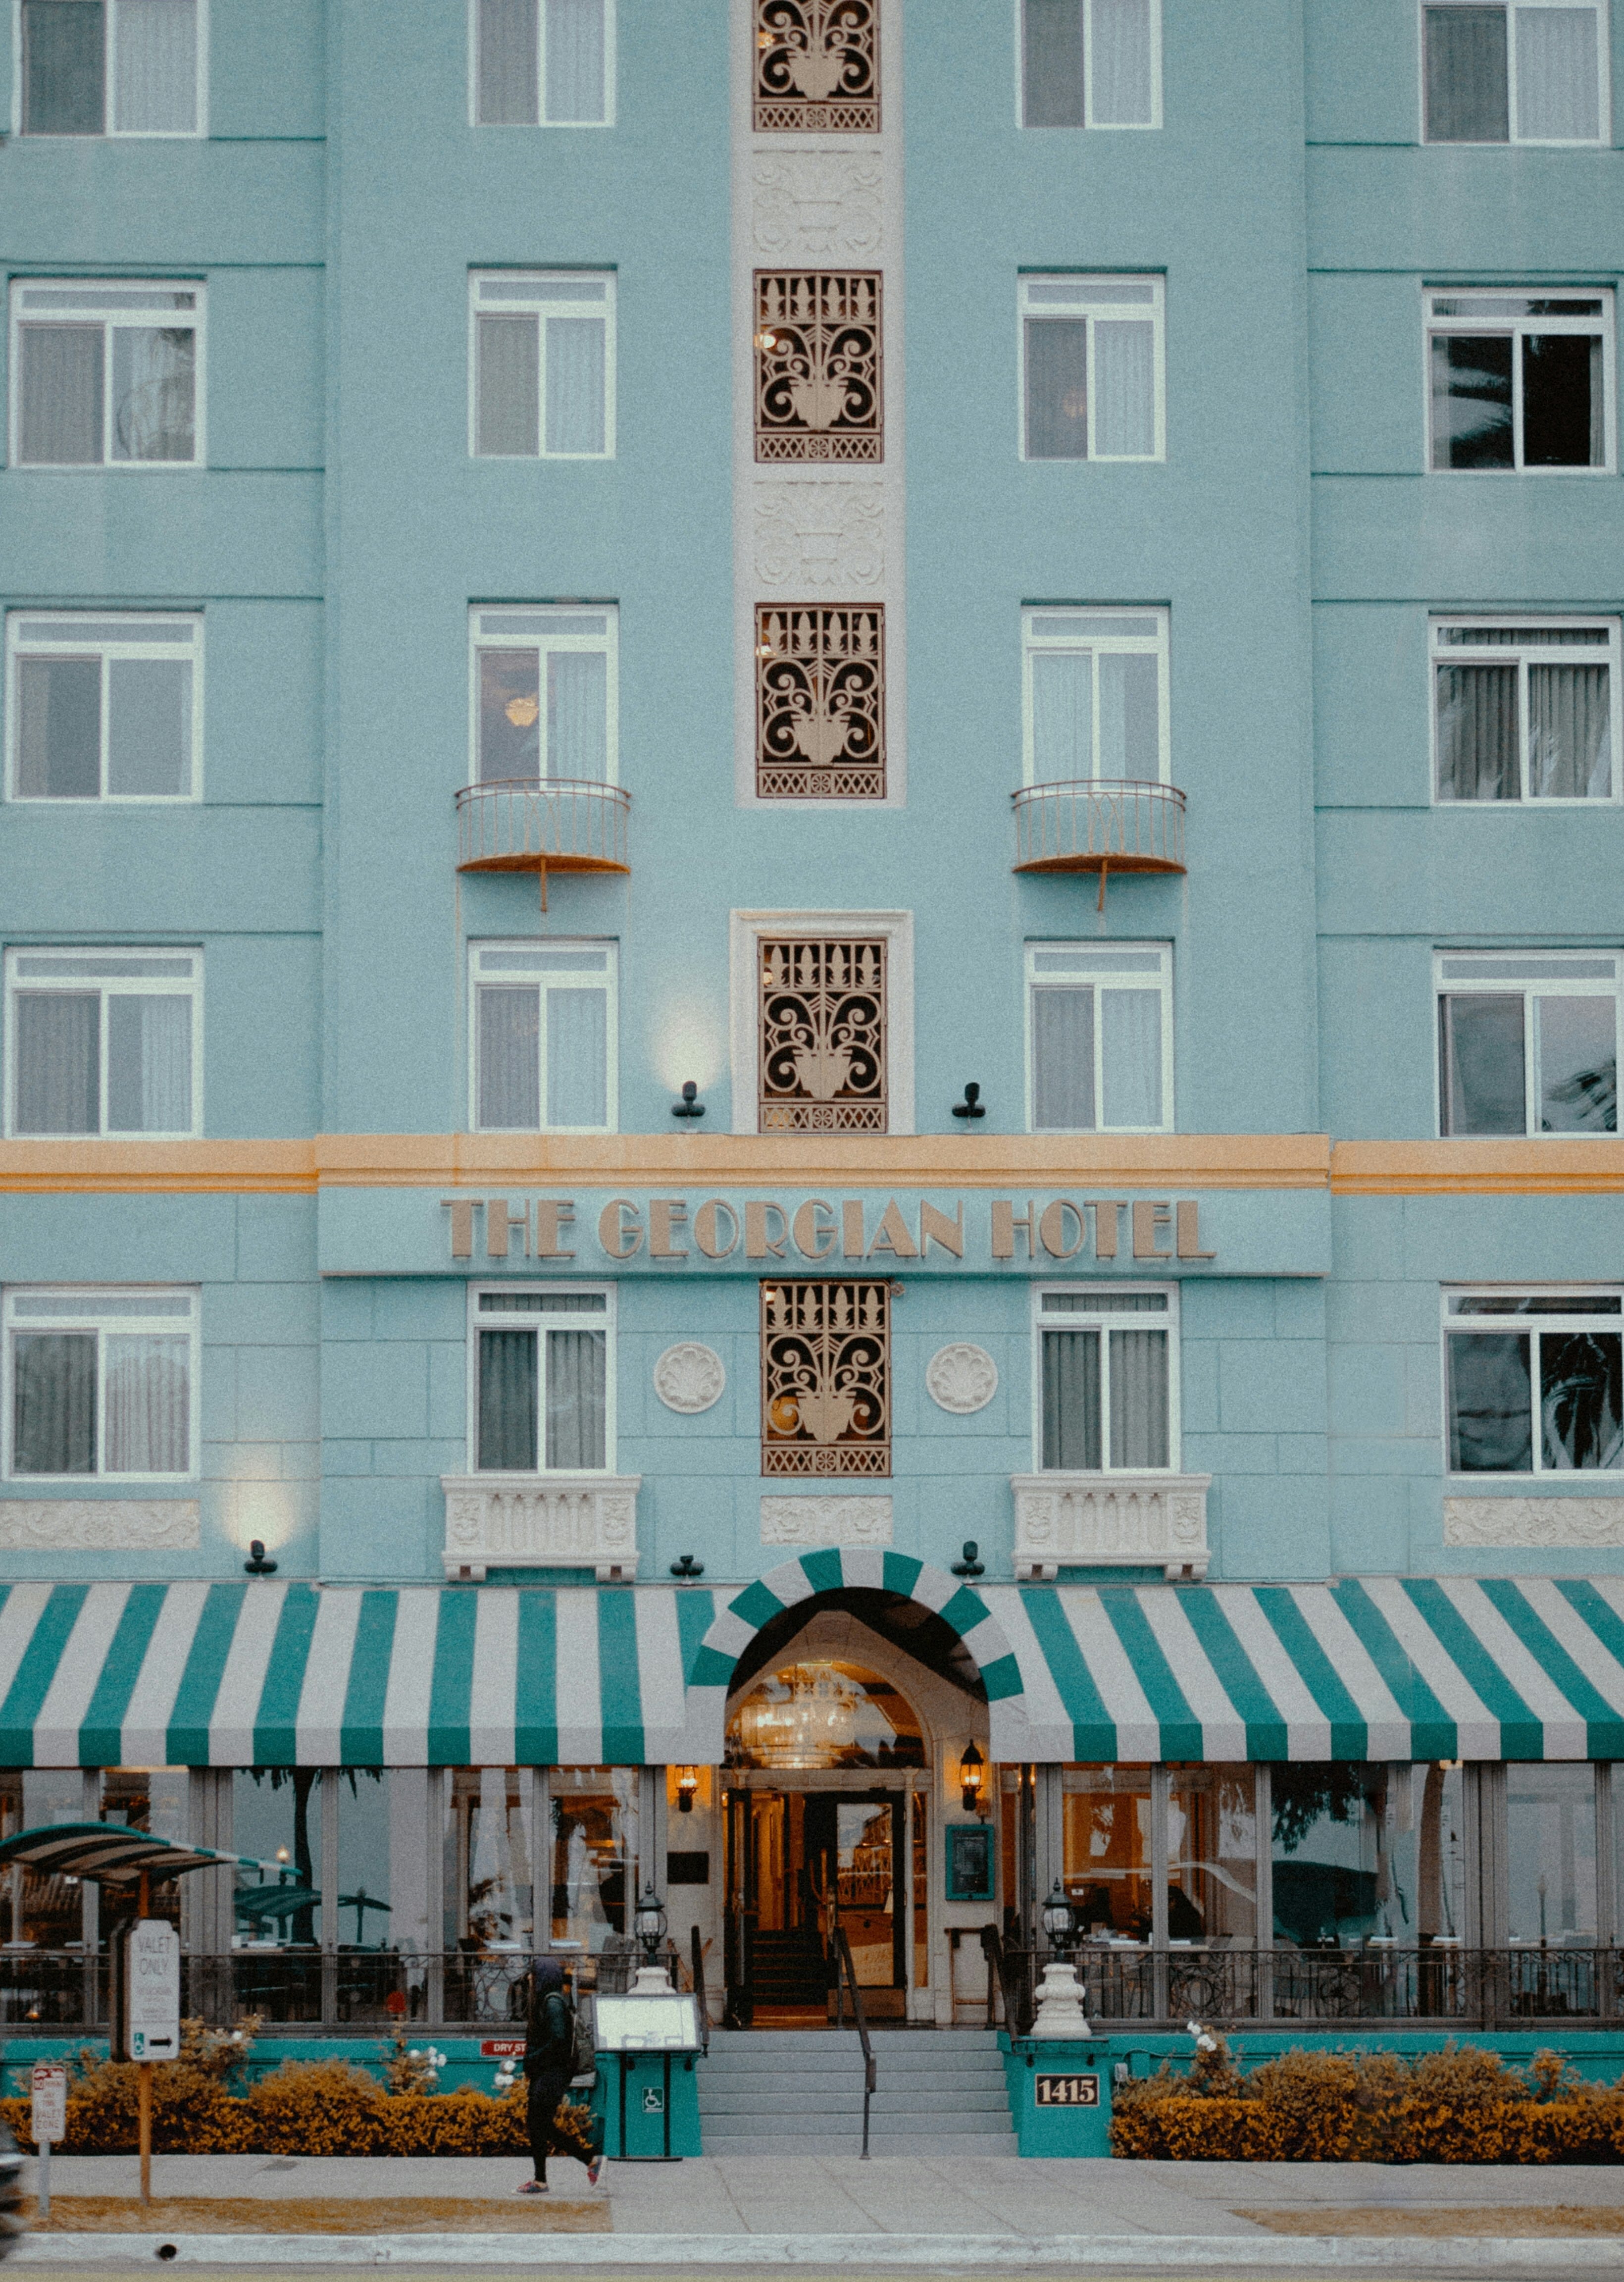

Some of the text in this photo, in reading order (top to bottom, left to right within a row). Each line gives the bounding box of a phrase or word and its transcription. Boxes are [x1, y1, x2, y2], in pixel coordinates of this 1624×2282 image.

[440, 1198, 1217, 1259] THE GEORGIAN HOTEL
[138, 1935, 171, 1954] VALET
[139, 1958, 169, 1976] ONLY
[493, 2043, 513, 2052] DRY
[1038, 2079, 1095, 2102] 1415
